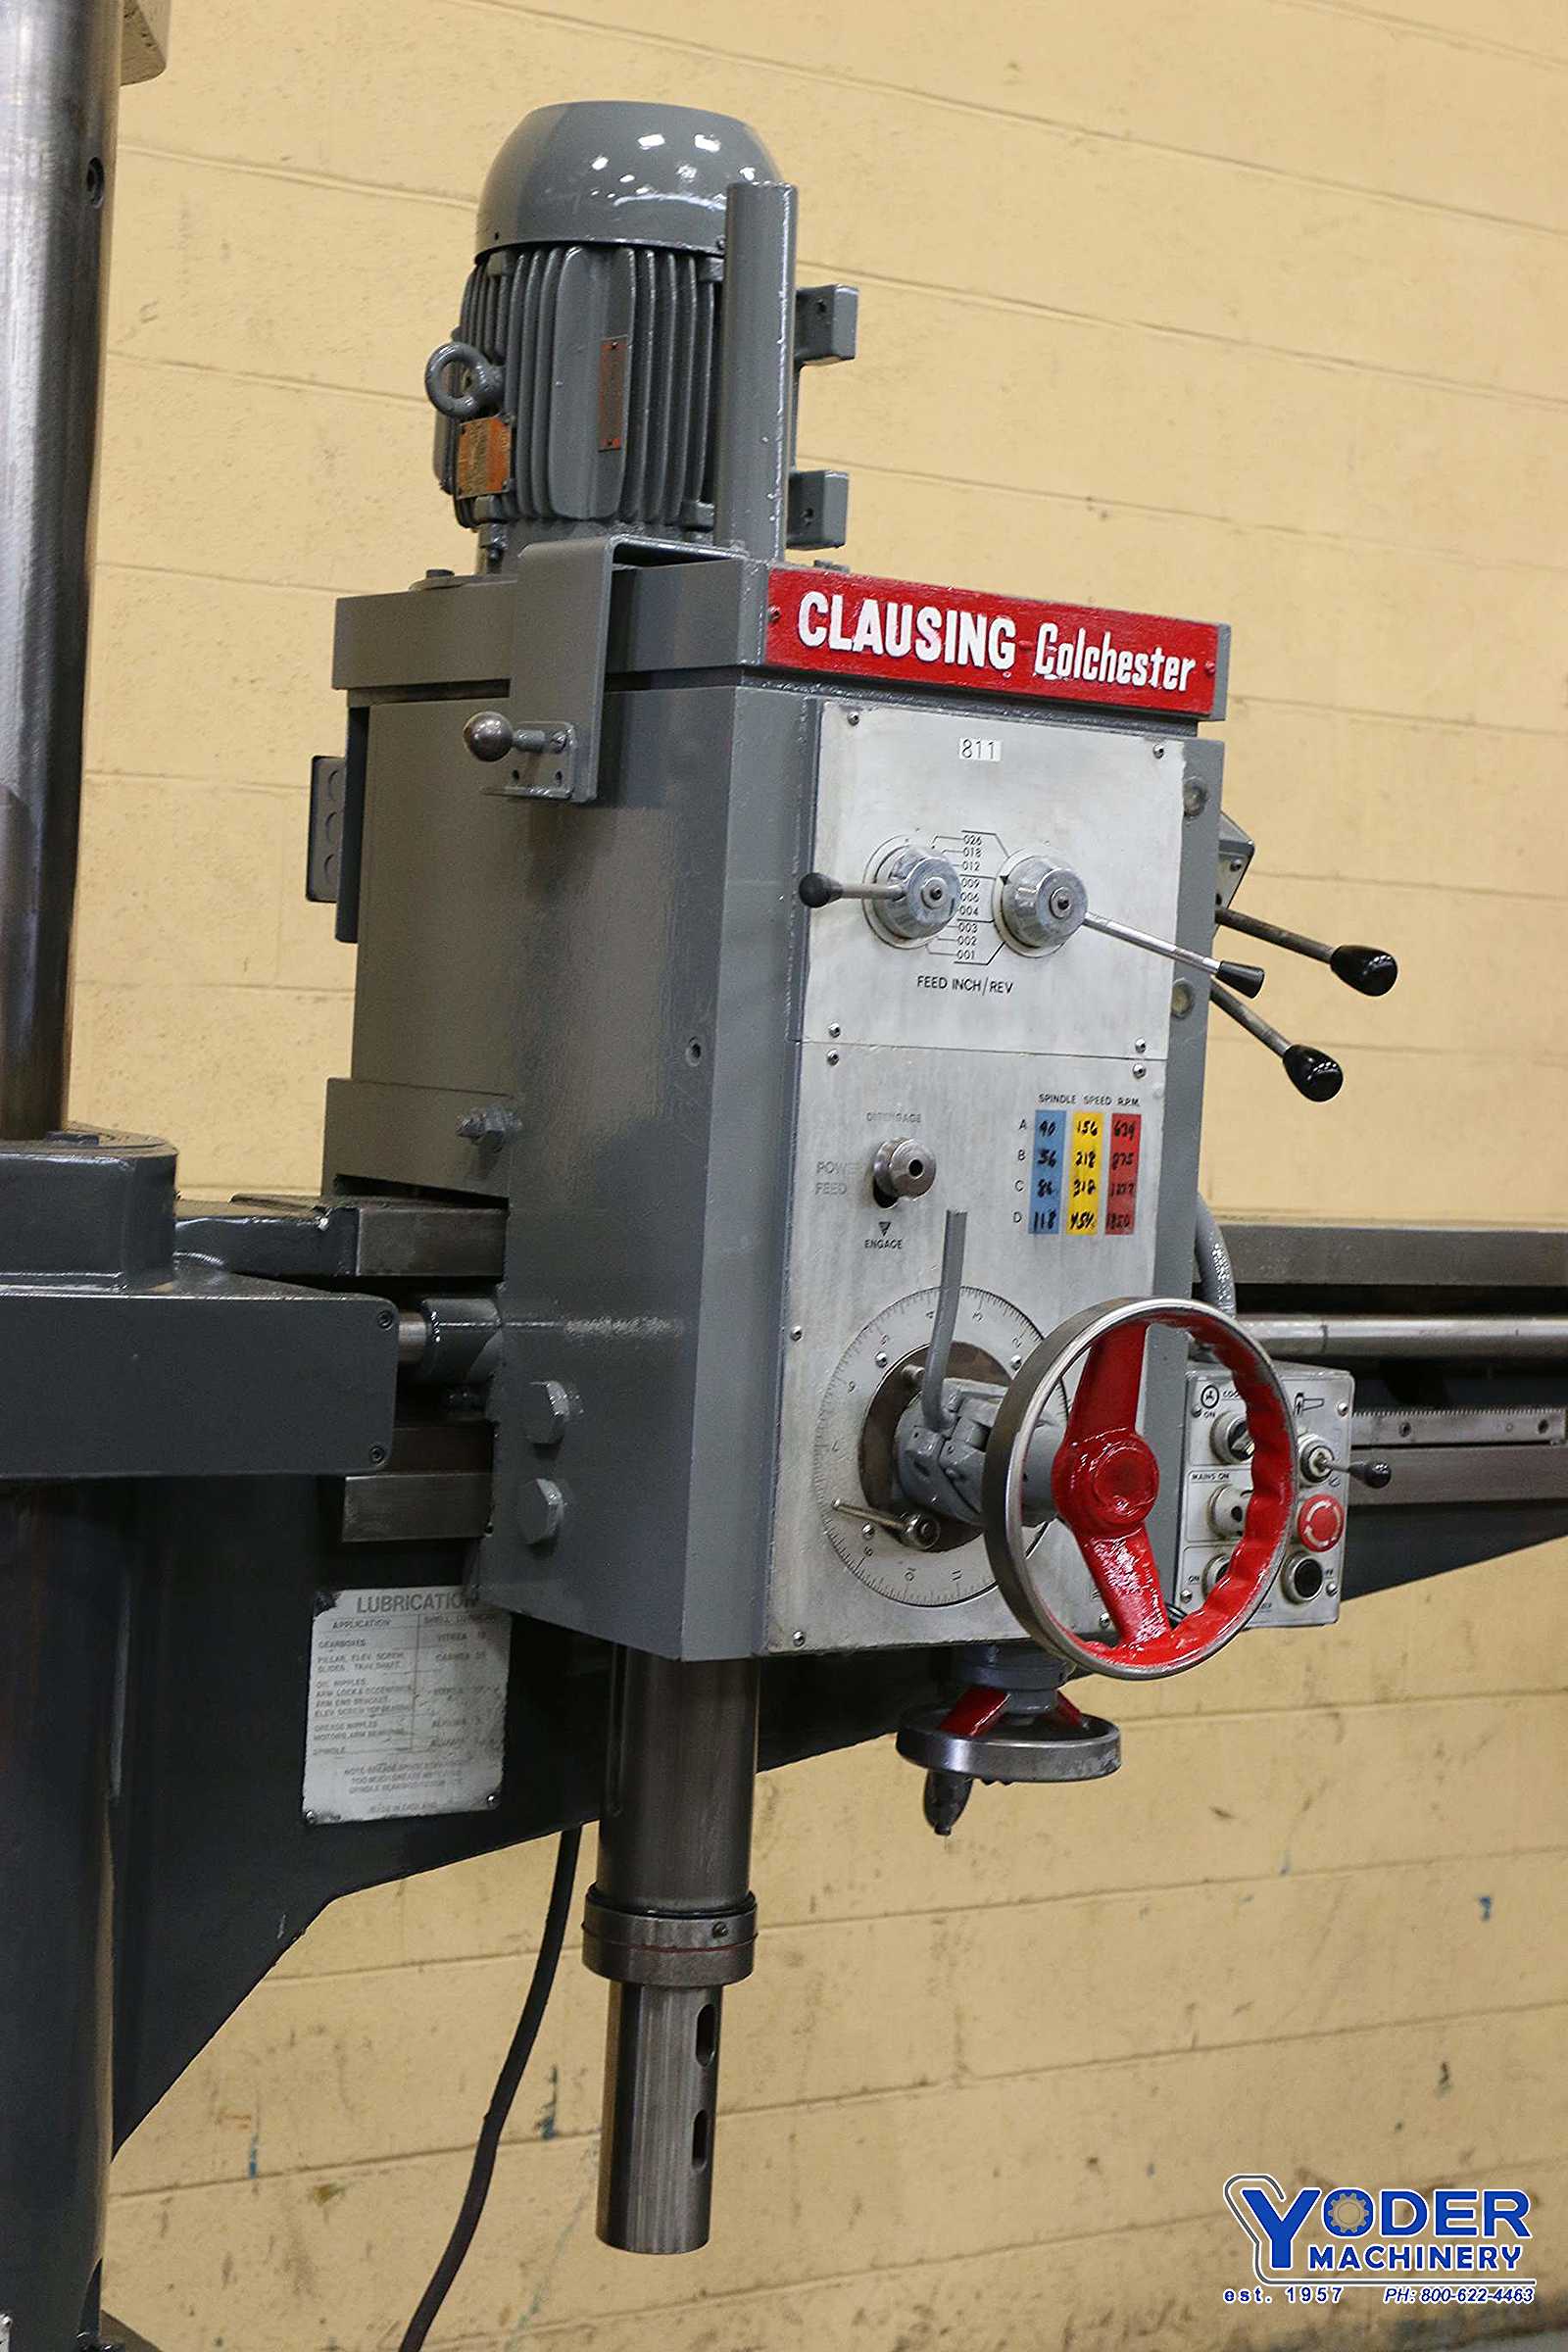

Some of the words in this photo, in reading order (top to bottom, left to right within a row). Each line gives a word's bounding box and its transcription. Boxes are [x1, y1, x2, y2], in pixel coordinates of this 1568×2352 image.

[798, 591, 1016, 671] CLAUSING
[1034, 622, 1196, 692] Colchester
[960, 739, 998, 760] 811
[956, 936, 976, 947] 002
[956, 950, 974, 960] 001
[917, 975, 948, 989] FEED
[1038, 1091, 1076, 1104] SPINDLE
[1083, 1093, 1111, 1105] SPEED
[1019, 1119, 1027, 1130] A
[1077, 1120, 1098, 1136] 156
[1017, 1150, 1026, 1160] B
[1014, 1180, 1024, 1192] C
[1013, 1211, 1022, 1223] D
[864, 1239, 903, 1250] ENGAGE
[332, 1620, 391, 1631] APPLICATION
